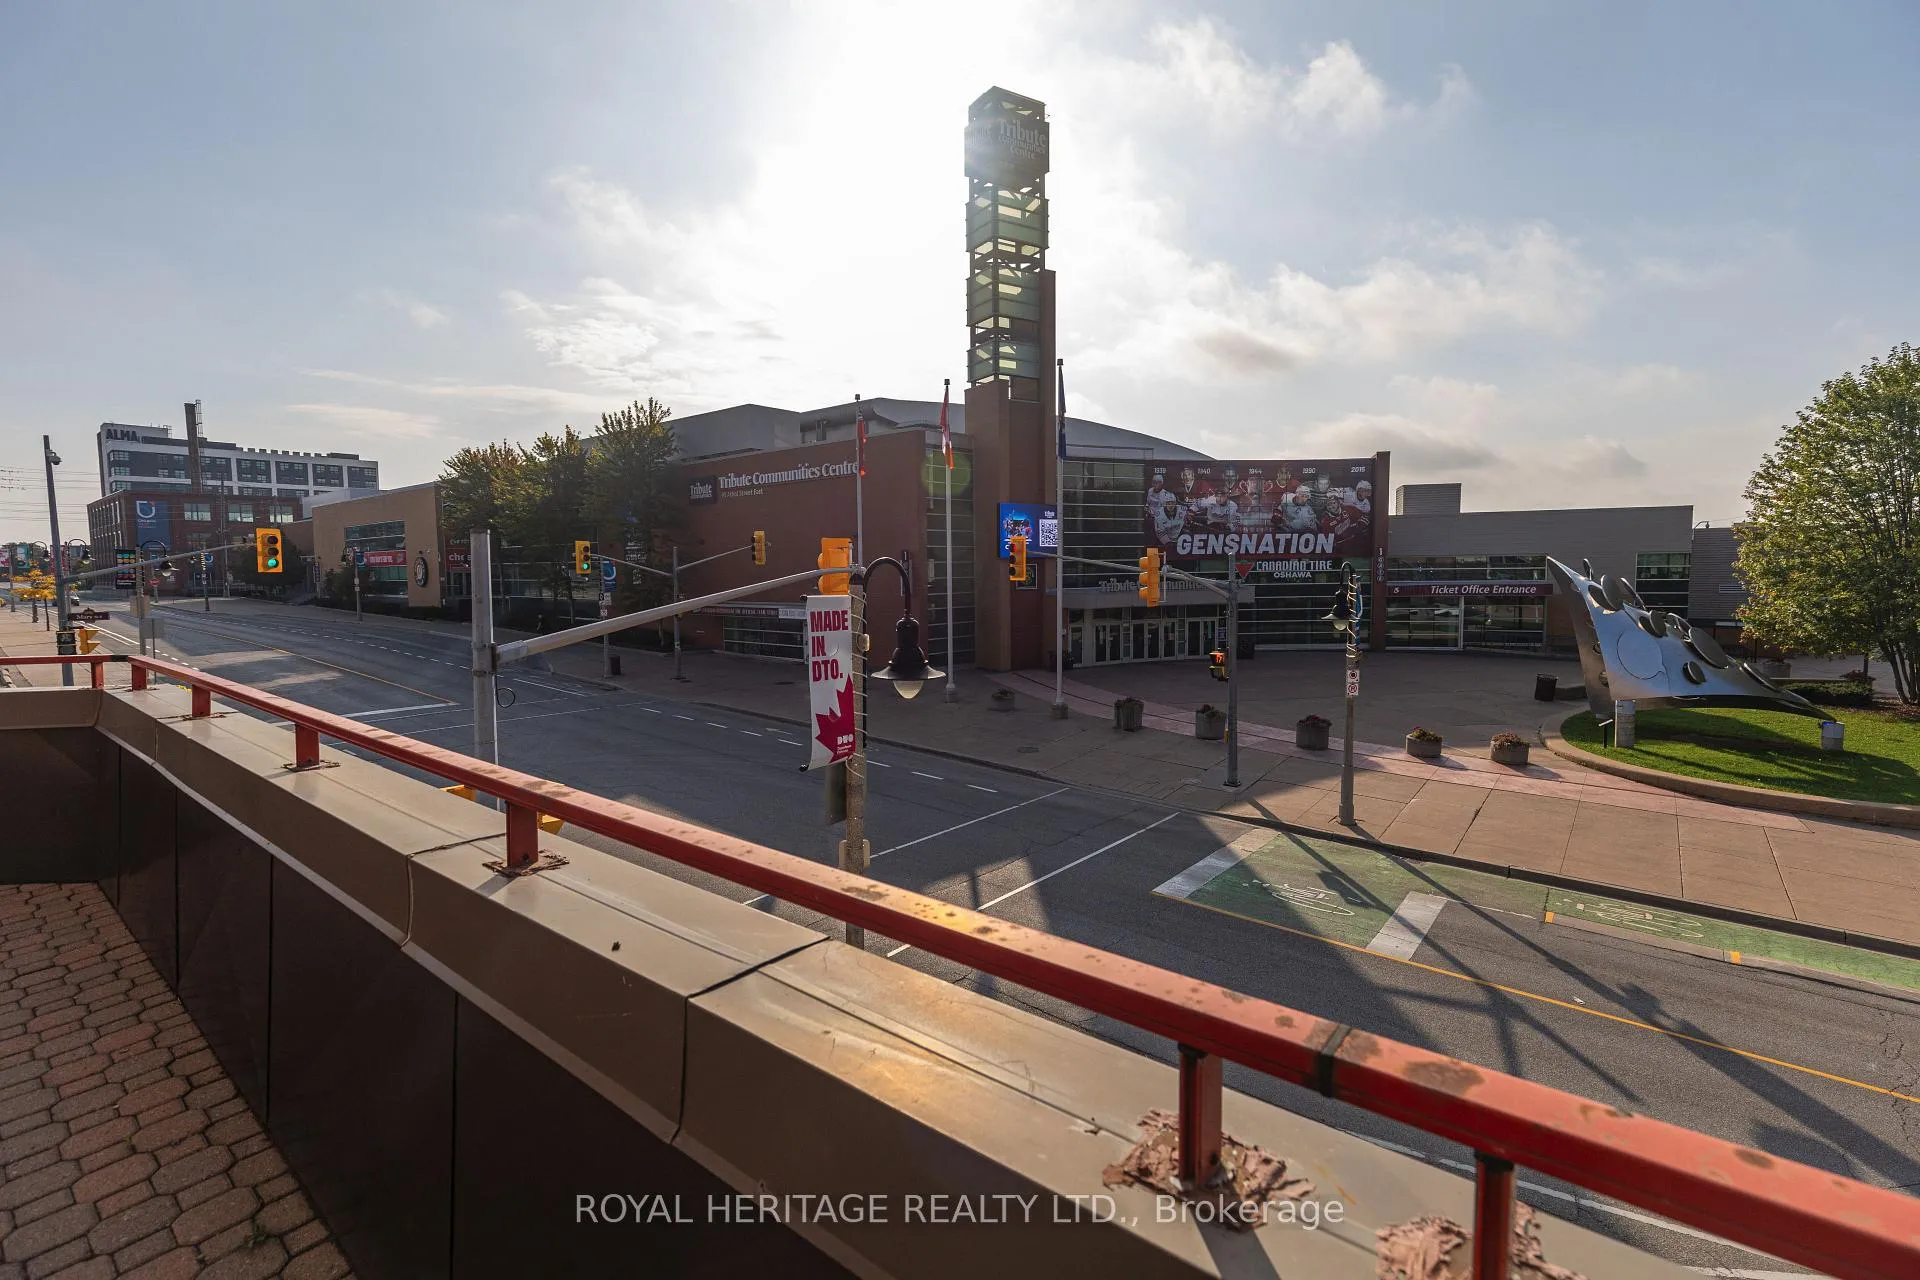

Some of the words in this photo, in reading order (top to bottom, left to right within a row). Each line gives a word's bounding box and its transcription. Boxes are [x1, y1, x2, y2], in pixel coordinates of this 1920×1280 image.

[999, 119, 1048, 147] Tribute
[106, 429, 137, 441] ALMA
[718, 473, 752, 488] Tribute
[753, 463, 820, 484] Communities
[822, 461, 859, 477] Centre
[690, 482, 712, 495] Tribute
[1176, 533, 1335, 555] GENSNATION
[1309, 560, 1333, 572] TIRE
[1098, 577, 1138, 592] Tribute
[1273, 571, 1312, 581] OSHAWA
[1430, 584, 1459, 594] Ticket
[1461, 584, 1490, 594] Office
[1492, 584, 1537, 594] Entrance
[809, 609, 849, 633] MADE
[811, 635, 827, 657] IN
[812, 659, 844, 682] DTO.
